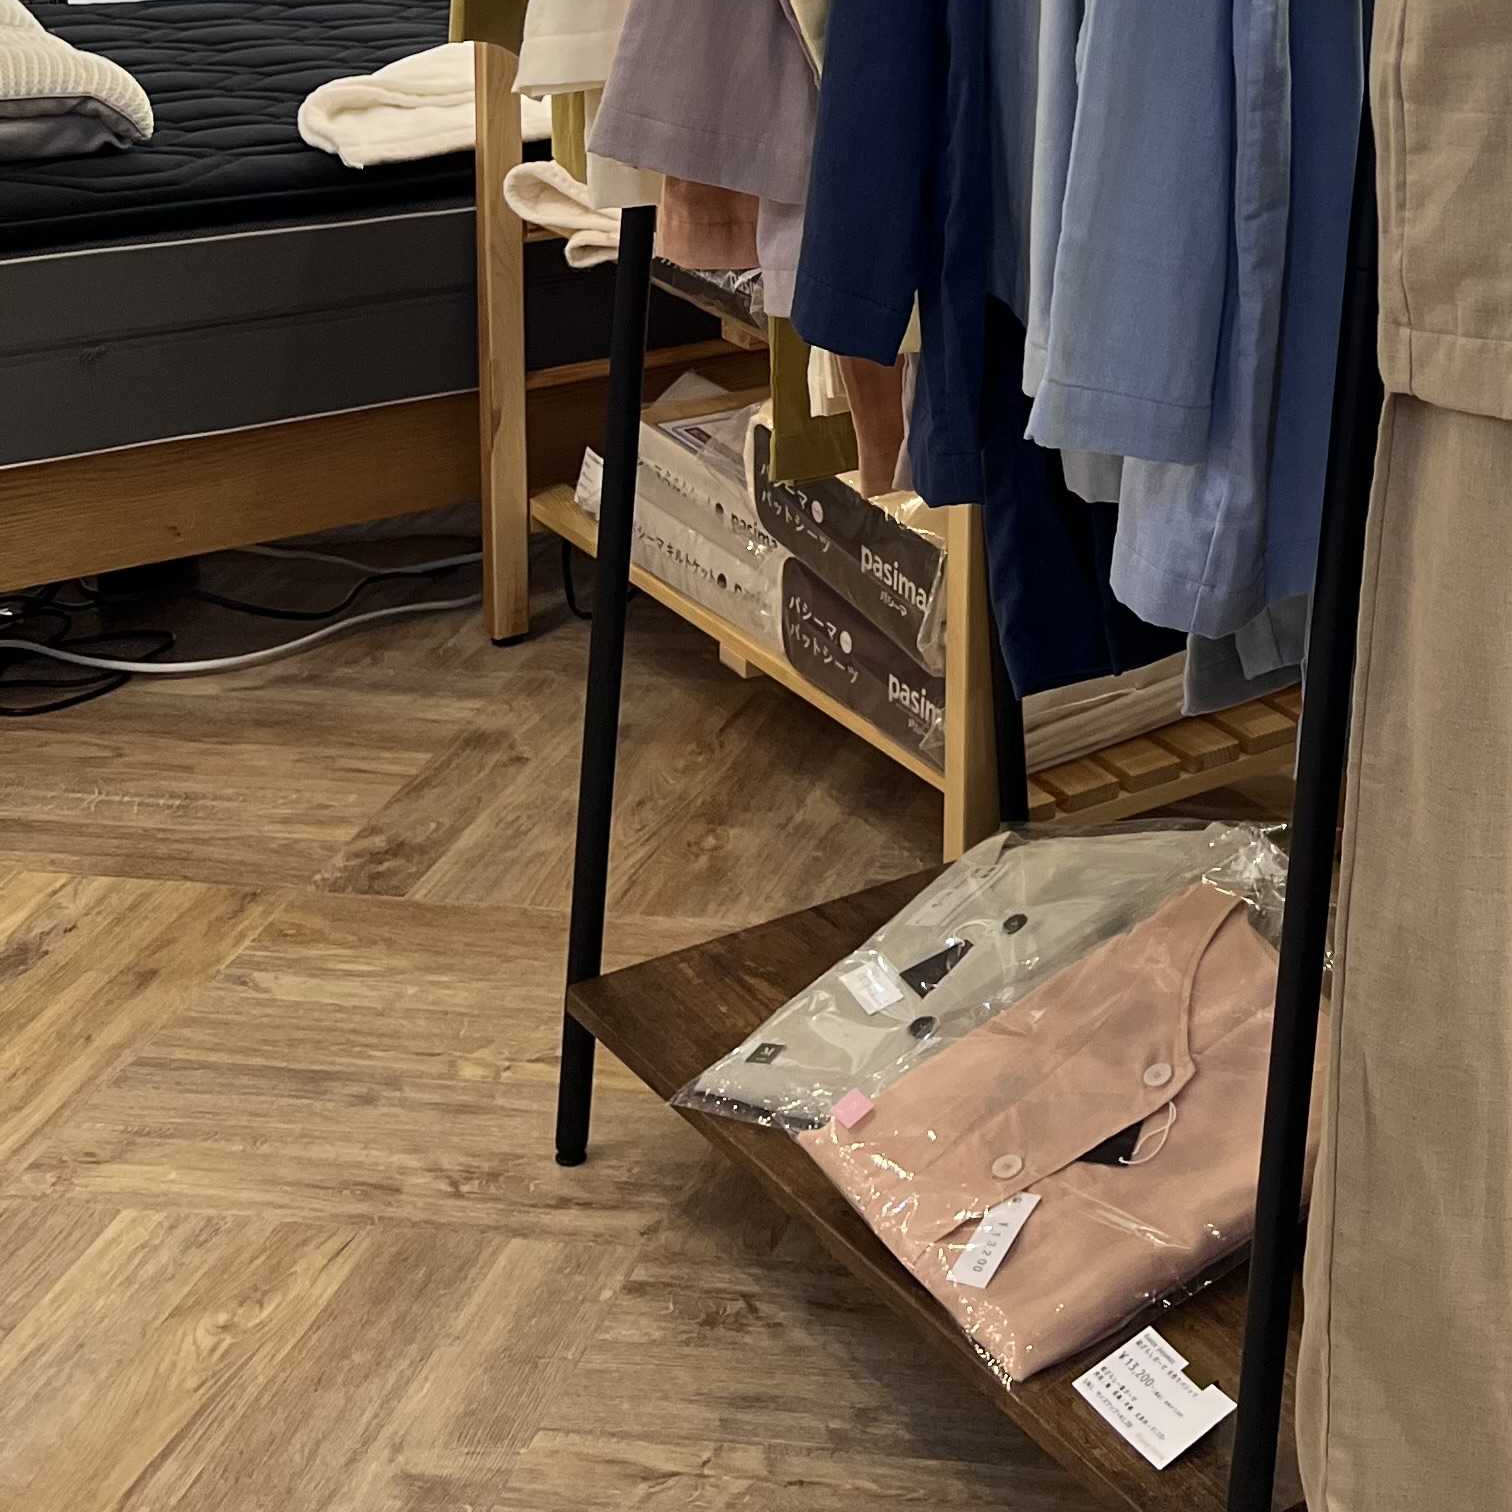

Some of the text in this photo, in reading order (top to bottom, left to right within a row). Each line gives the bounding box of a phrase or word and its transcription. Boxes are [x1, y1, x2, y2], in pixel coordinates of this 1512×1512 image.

[860, 543, 928, 612] pasima
[789, 595, 837, 639] パシーマ
[888, 673, 943, 725] pasim
